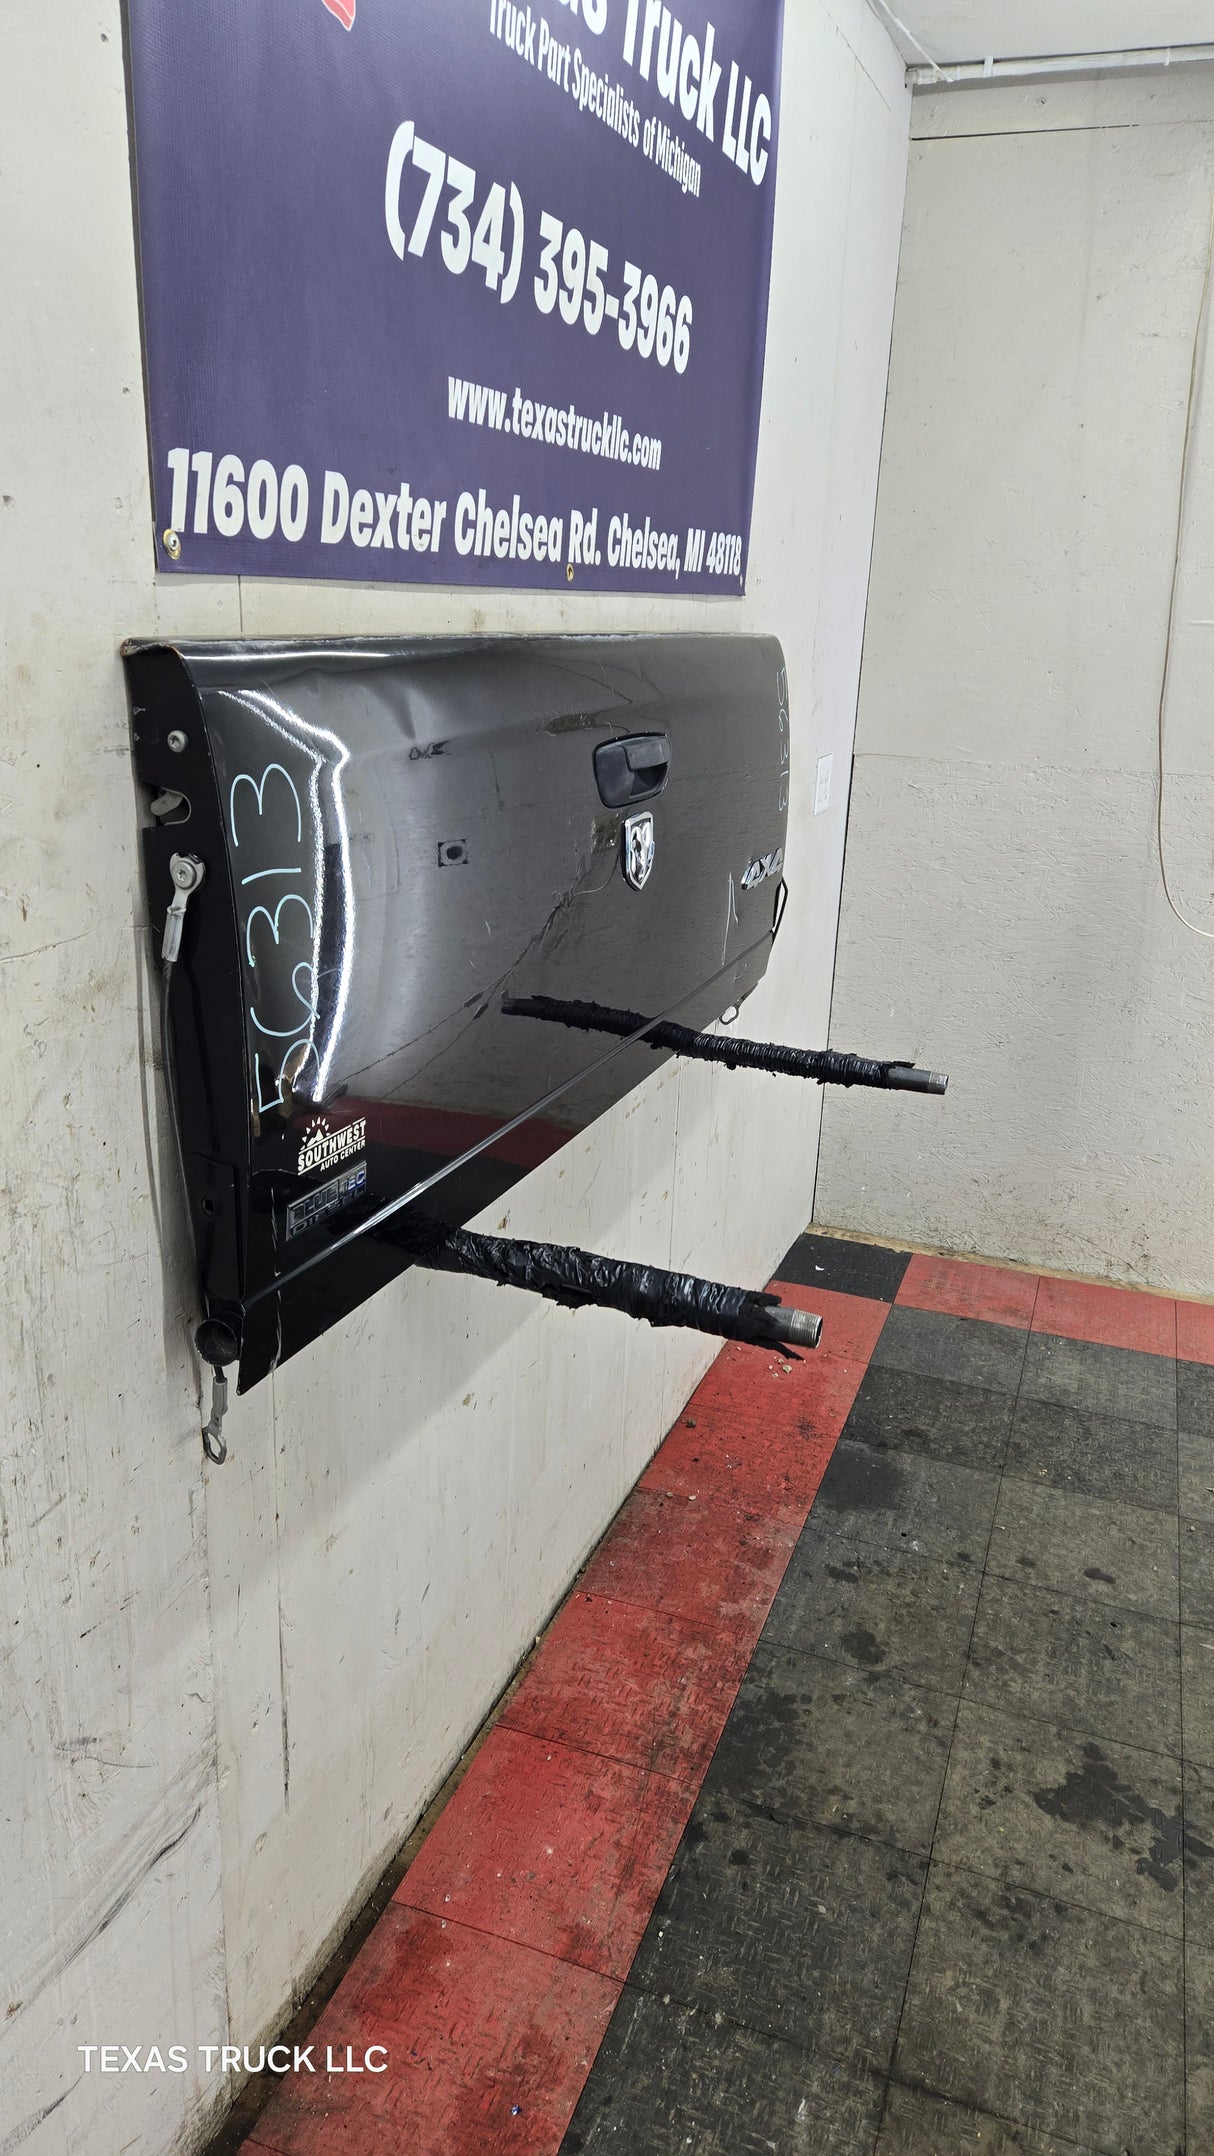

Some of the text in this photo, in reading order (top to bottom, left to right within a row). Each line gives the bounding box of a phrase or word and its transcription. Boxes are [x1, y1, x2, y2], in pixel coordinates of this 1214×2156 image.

[537, 16, 572, 93] Part
[571, 48, 641, 148] Specialists
[643, 116, 657, 160] of
[655, 120, 701, 198] Michigan
[721, 59, 772, 186] LLC
[385, 120, 693, 374] (734) 395-3966
[448, 376, 662, 470] www.texastruckllc.com
[167, 447, 743, 580] 11600 Dexter Chelsea Rd. Chelsea, MI 48118
[230, 763, 323, 1113] 56313
[297, 1120, 366, 1172] SOUTHWEST
[320, 1139, 366, 1172] AUTO CENTER
